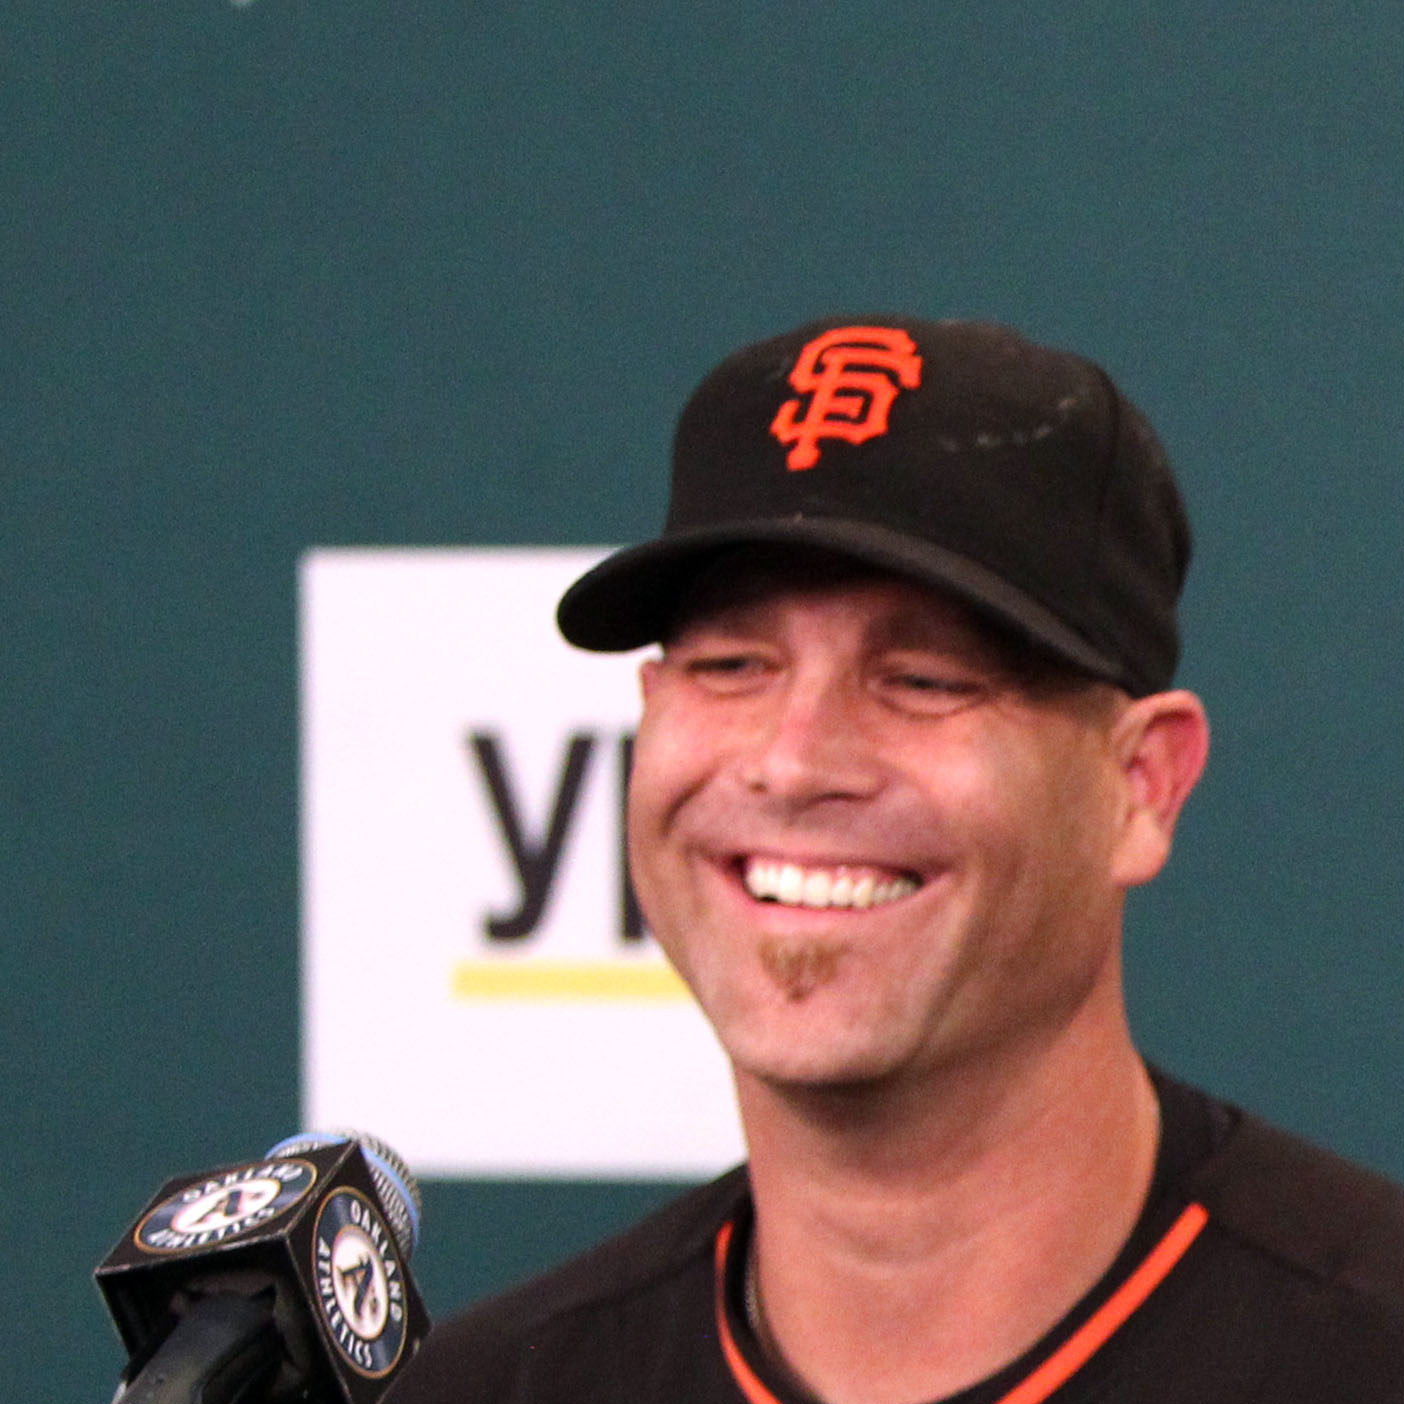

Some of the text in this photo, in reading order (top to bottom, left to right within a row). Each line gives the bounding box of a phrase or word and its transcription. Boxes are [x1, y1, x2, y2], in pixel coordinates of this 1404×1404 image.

[769, 325, 922, 472] SF
[465, 726, 640, 946] y
[317, 1236, 373, 1368] ATHLETICS
[351, 1199, 403, 1322] OAKLAND
